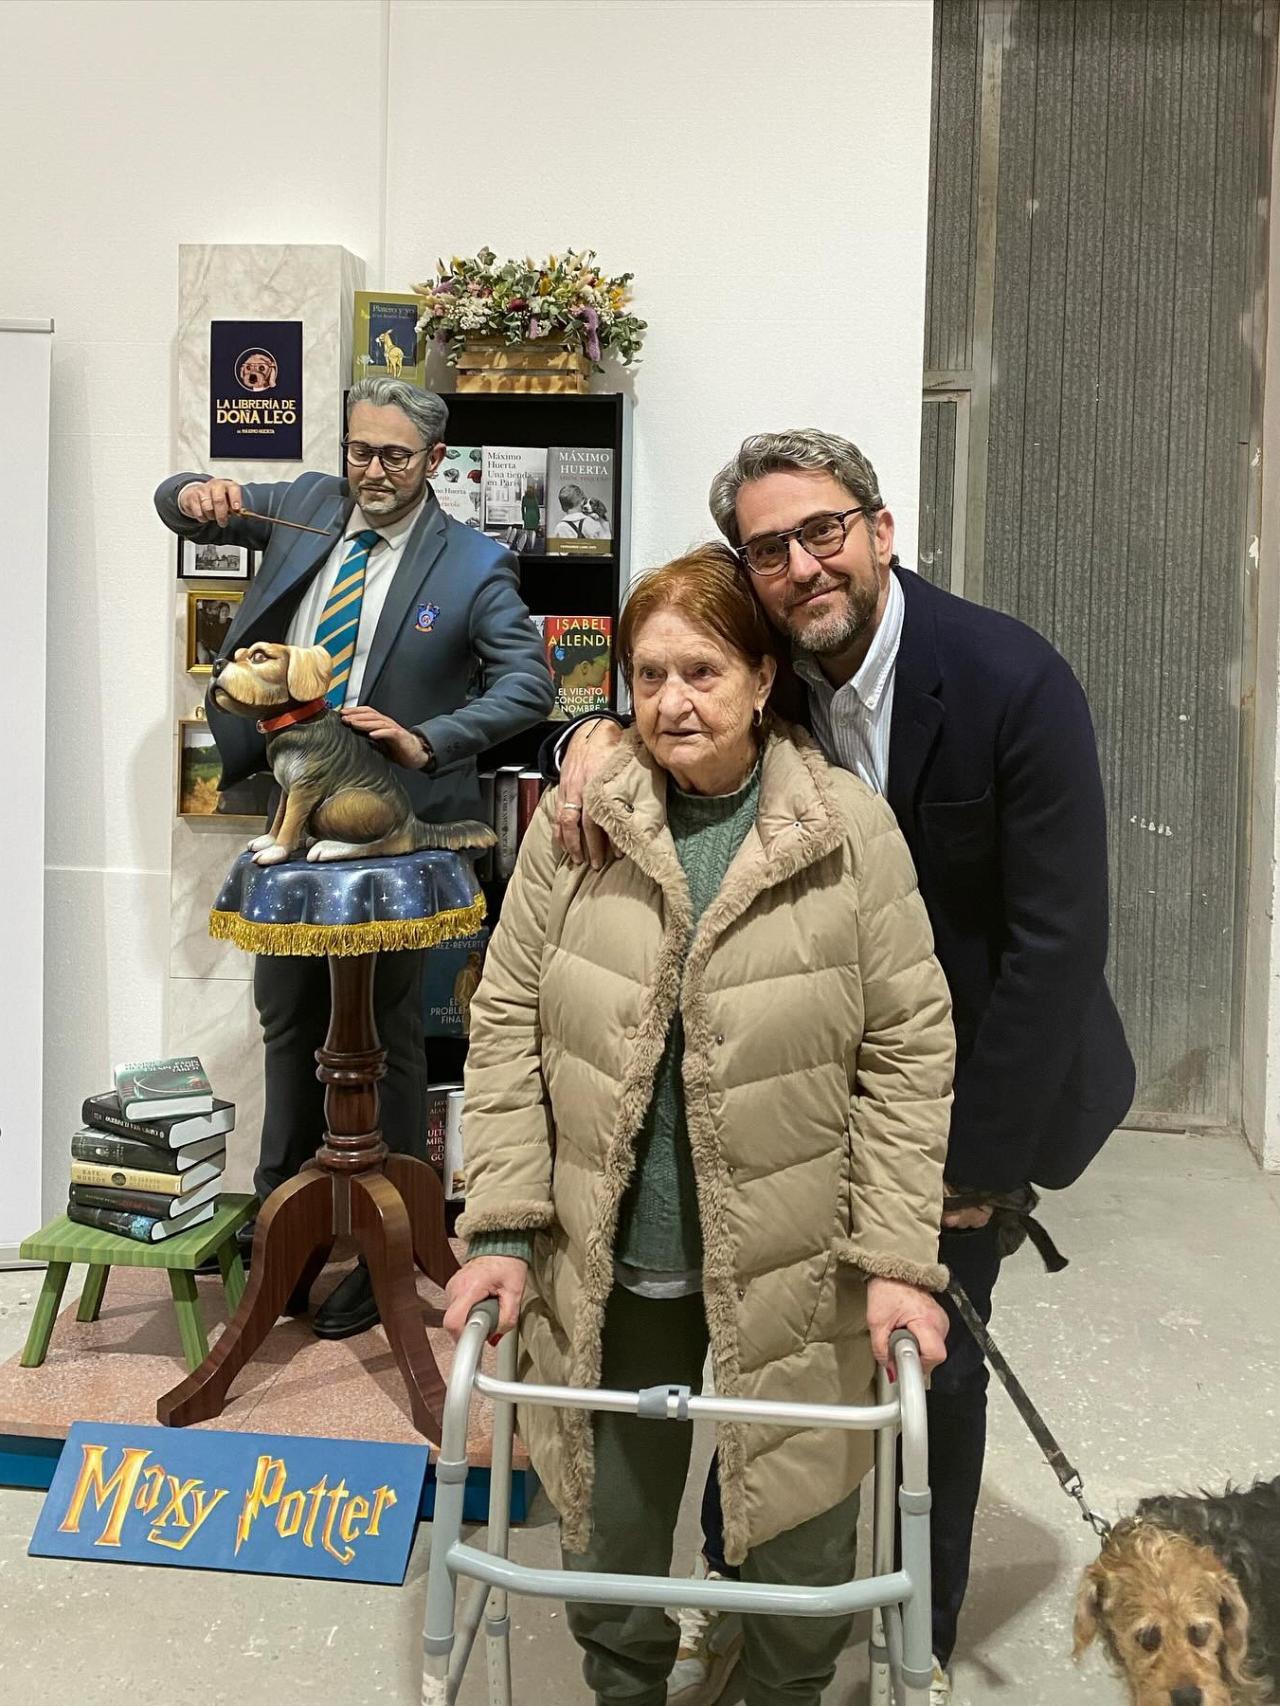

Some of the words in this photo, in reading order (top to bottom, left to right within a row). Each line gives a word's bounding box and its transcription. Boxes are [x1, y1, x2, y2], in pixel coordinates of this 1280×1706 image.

[216, 399, 230, 409] LA
[232, 397, 280, 409] LIBRERÍA
[281, 400, 296, 410] DE
[216, 409, 261, 424] DOÑA
[263, 410, 297, 425] LEO
[487, 452, 522, 461] Máximo
[559, 449, 610, 462] MÁXIMO
[487, 461, 516, 469] Huerta
[560, 464, 608, 475] HUERTA
[487, 470, 504, 478] Una
[556, 618, 606, 630] ISABEL
[558, 687, 568, 696] EL
[569, 687, 603, 696] VIENTO
[554, 696, 594, 705] CONOCE
[57, 1443, 230, 1551] Maxy
[233, 1455, 398, 1566] Potter
